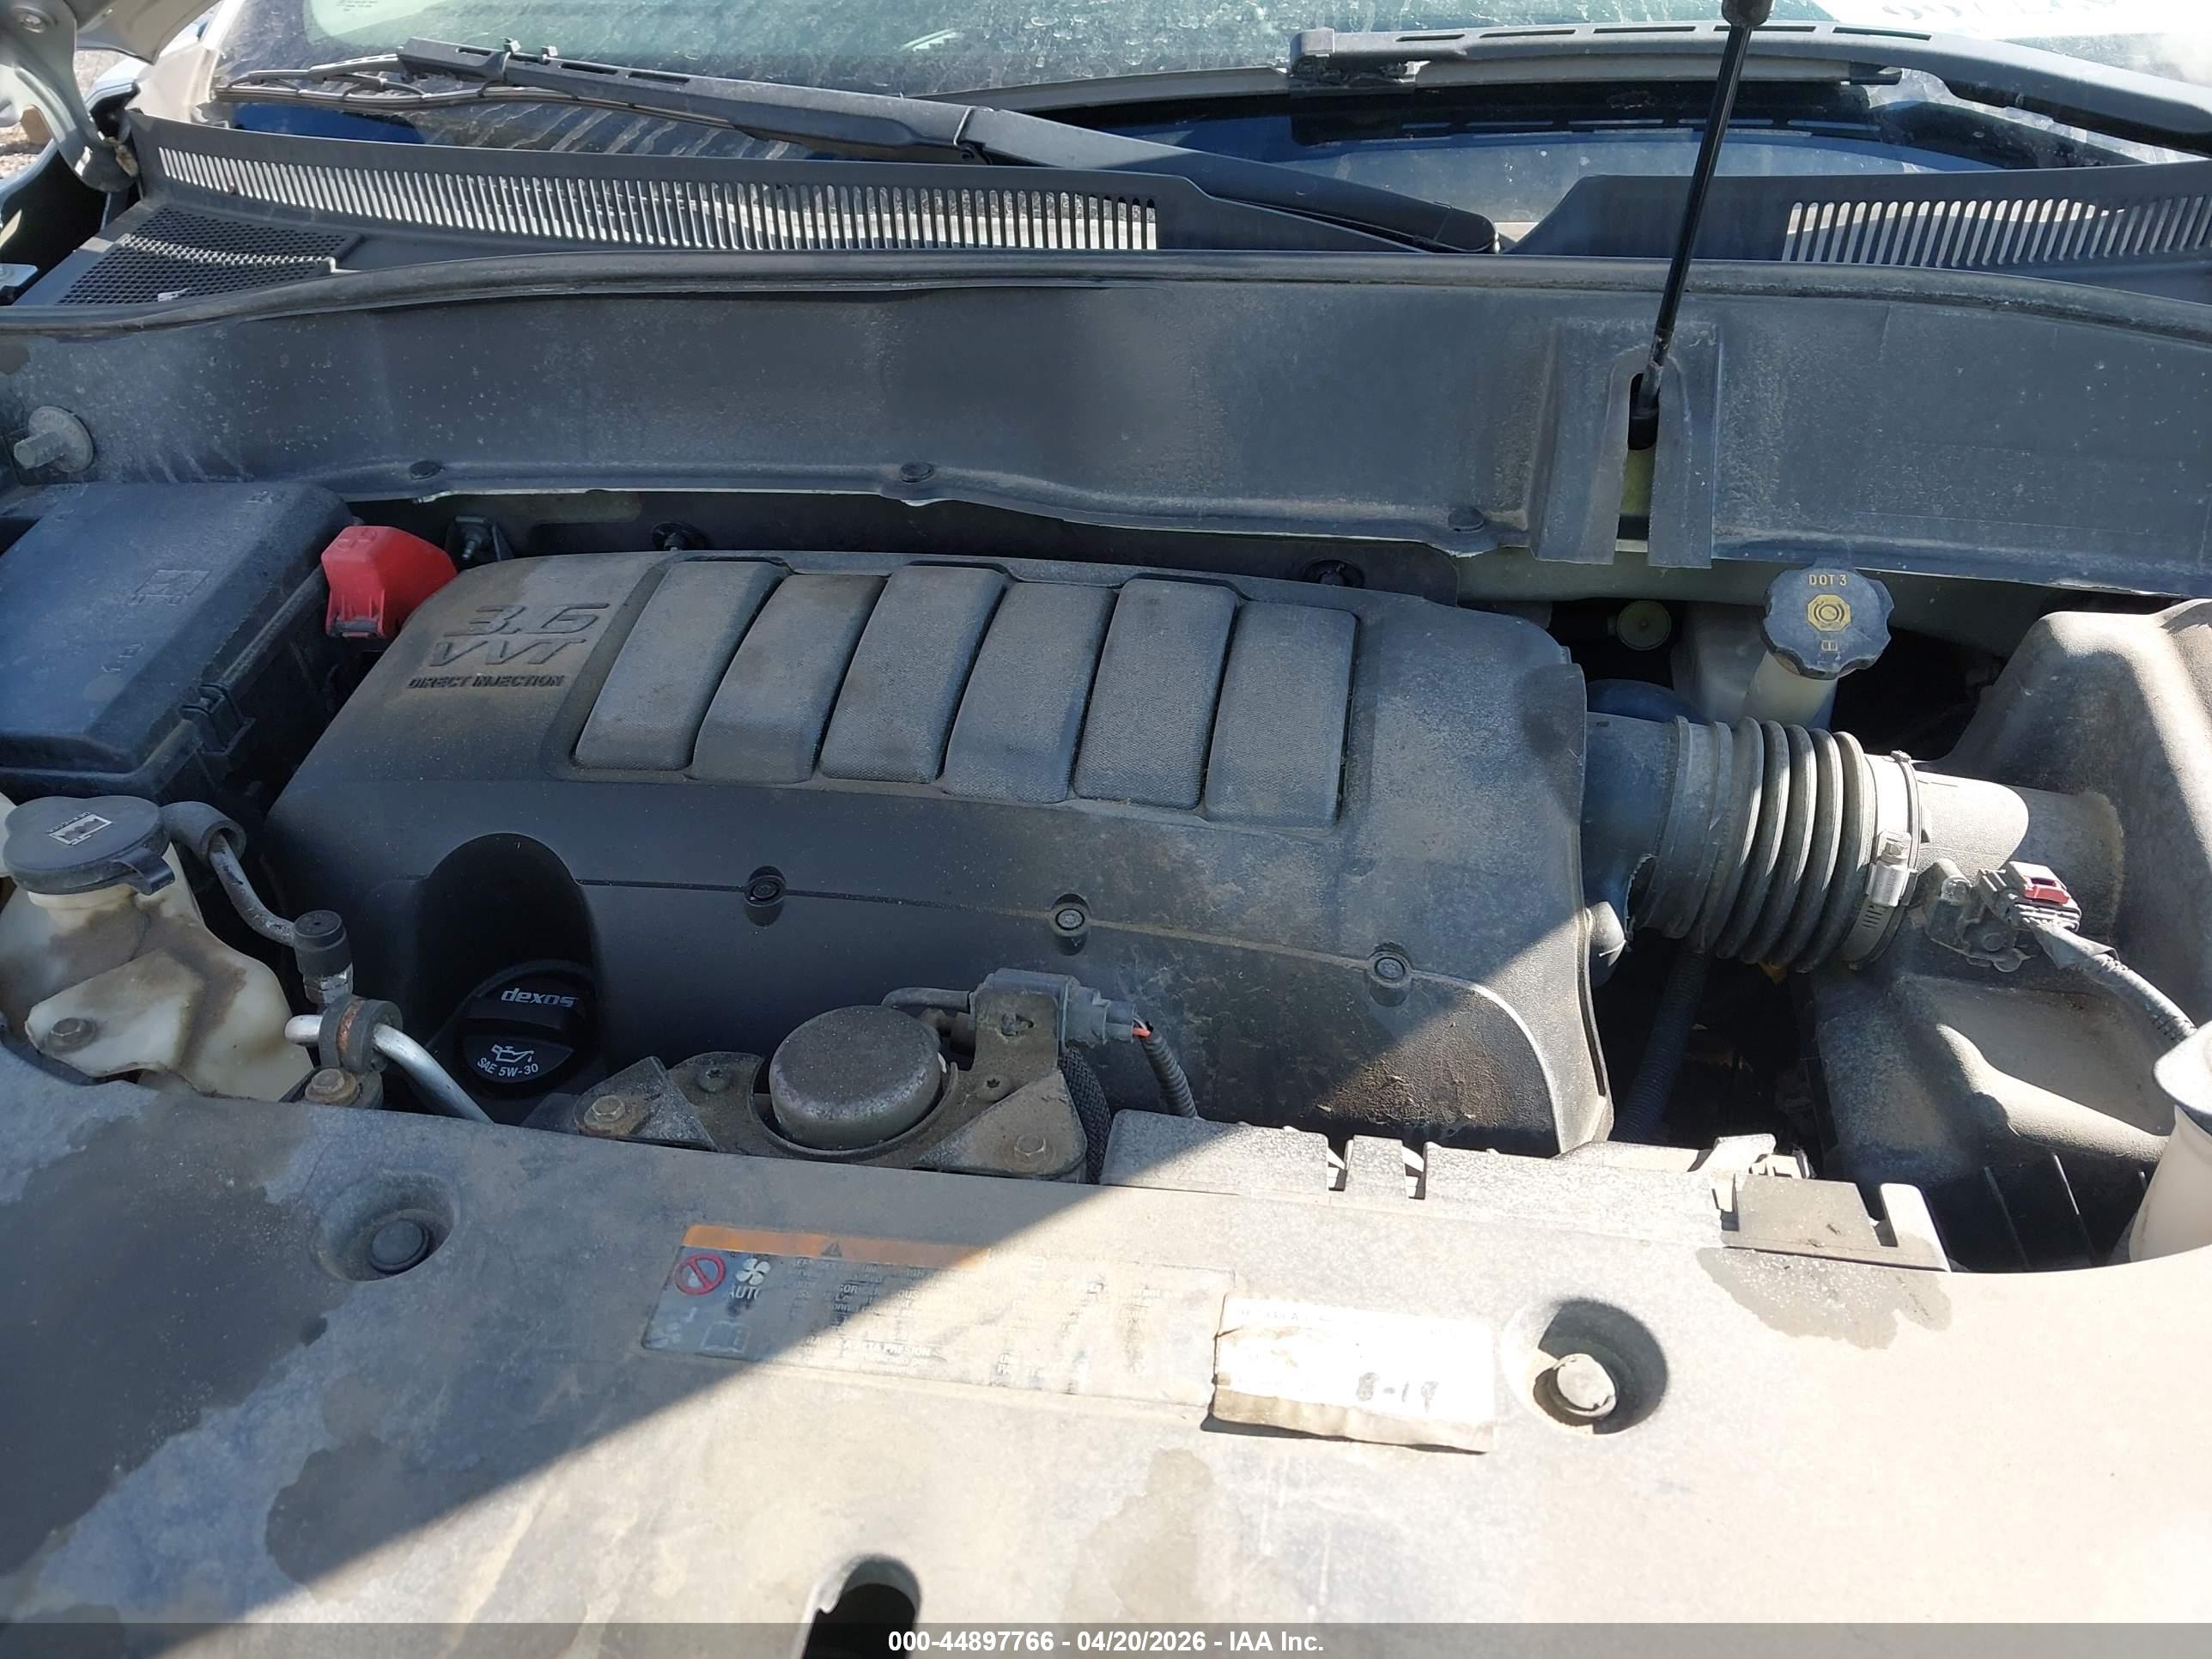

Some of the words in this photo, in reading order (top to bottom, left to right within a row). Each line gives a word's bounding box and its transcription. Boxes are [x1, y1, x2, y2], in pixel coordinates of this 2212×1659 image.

[1808, 574, 1836, 586] DOT
[1839, 574, 1848, 586] 3
[443, 603, 611, 637] 3.6
[428, 638, 586, 668] VVT
[406, 674, 473, 690] DIRECT
[471, 673, 565, 689] INJECTION
[501, 988, 579, 1008] dexos
[477, 1056, 496, 1075] SAE
[497, 1063, 539, 1078] 5W-30
